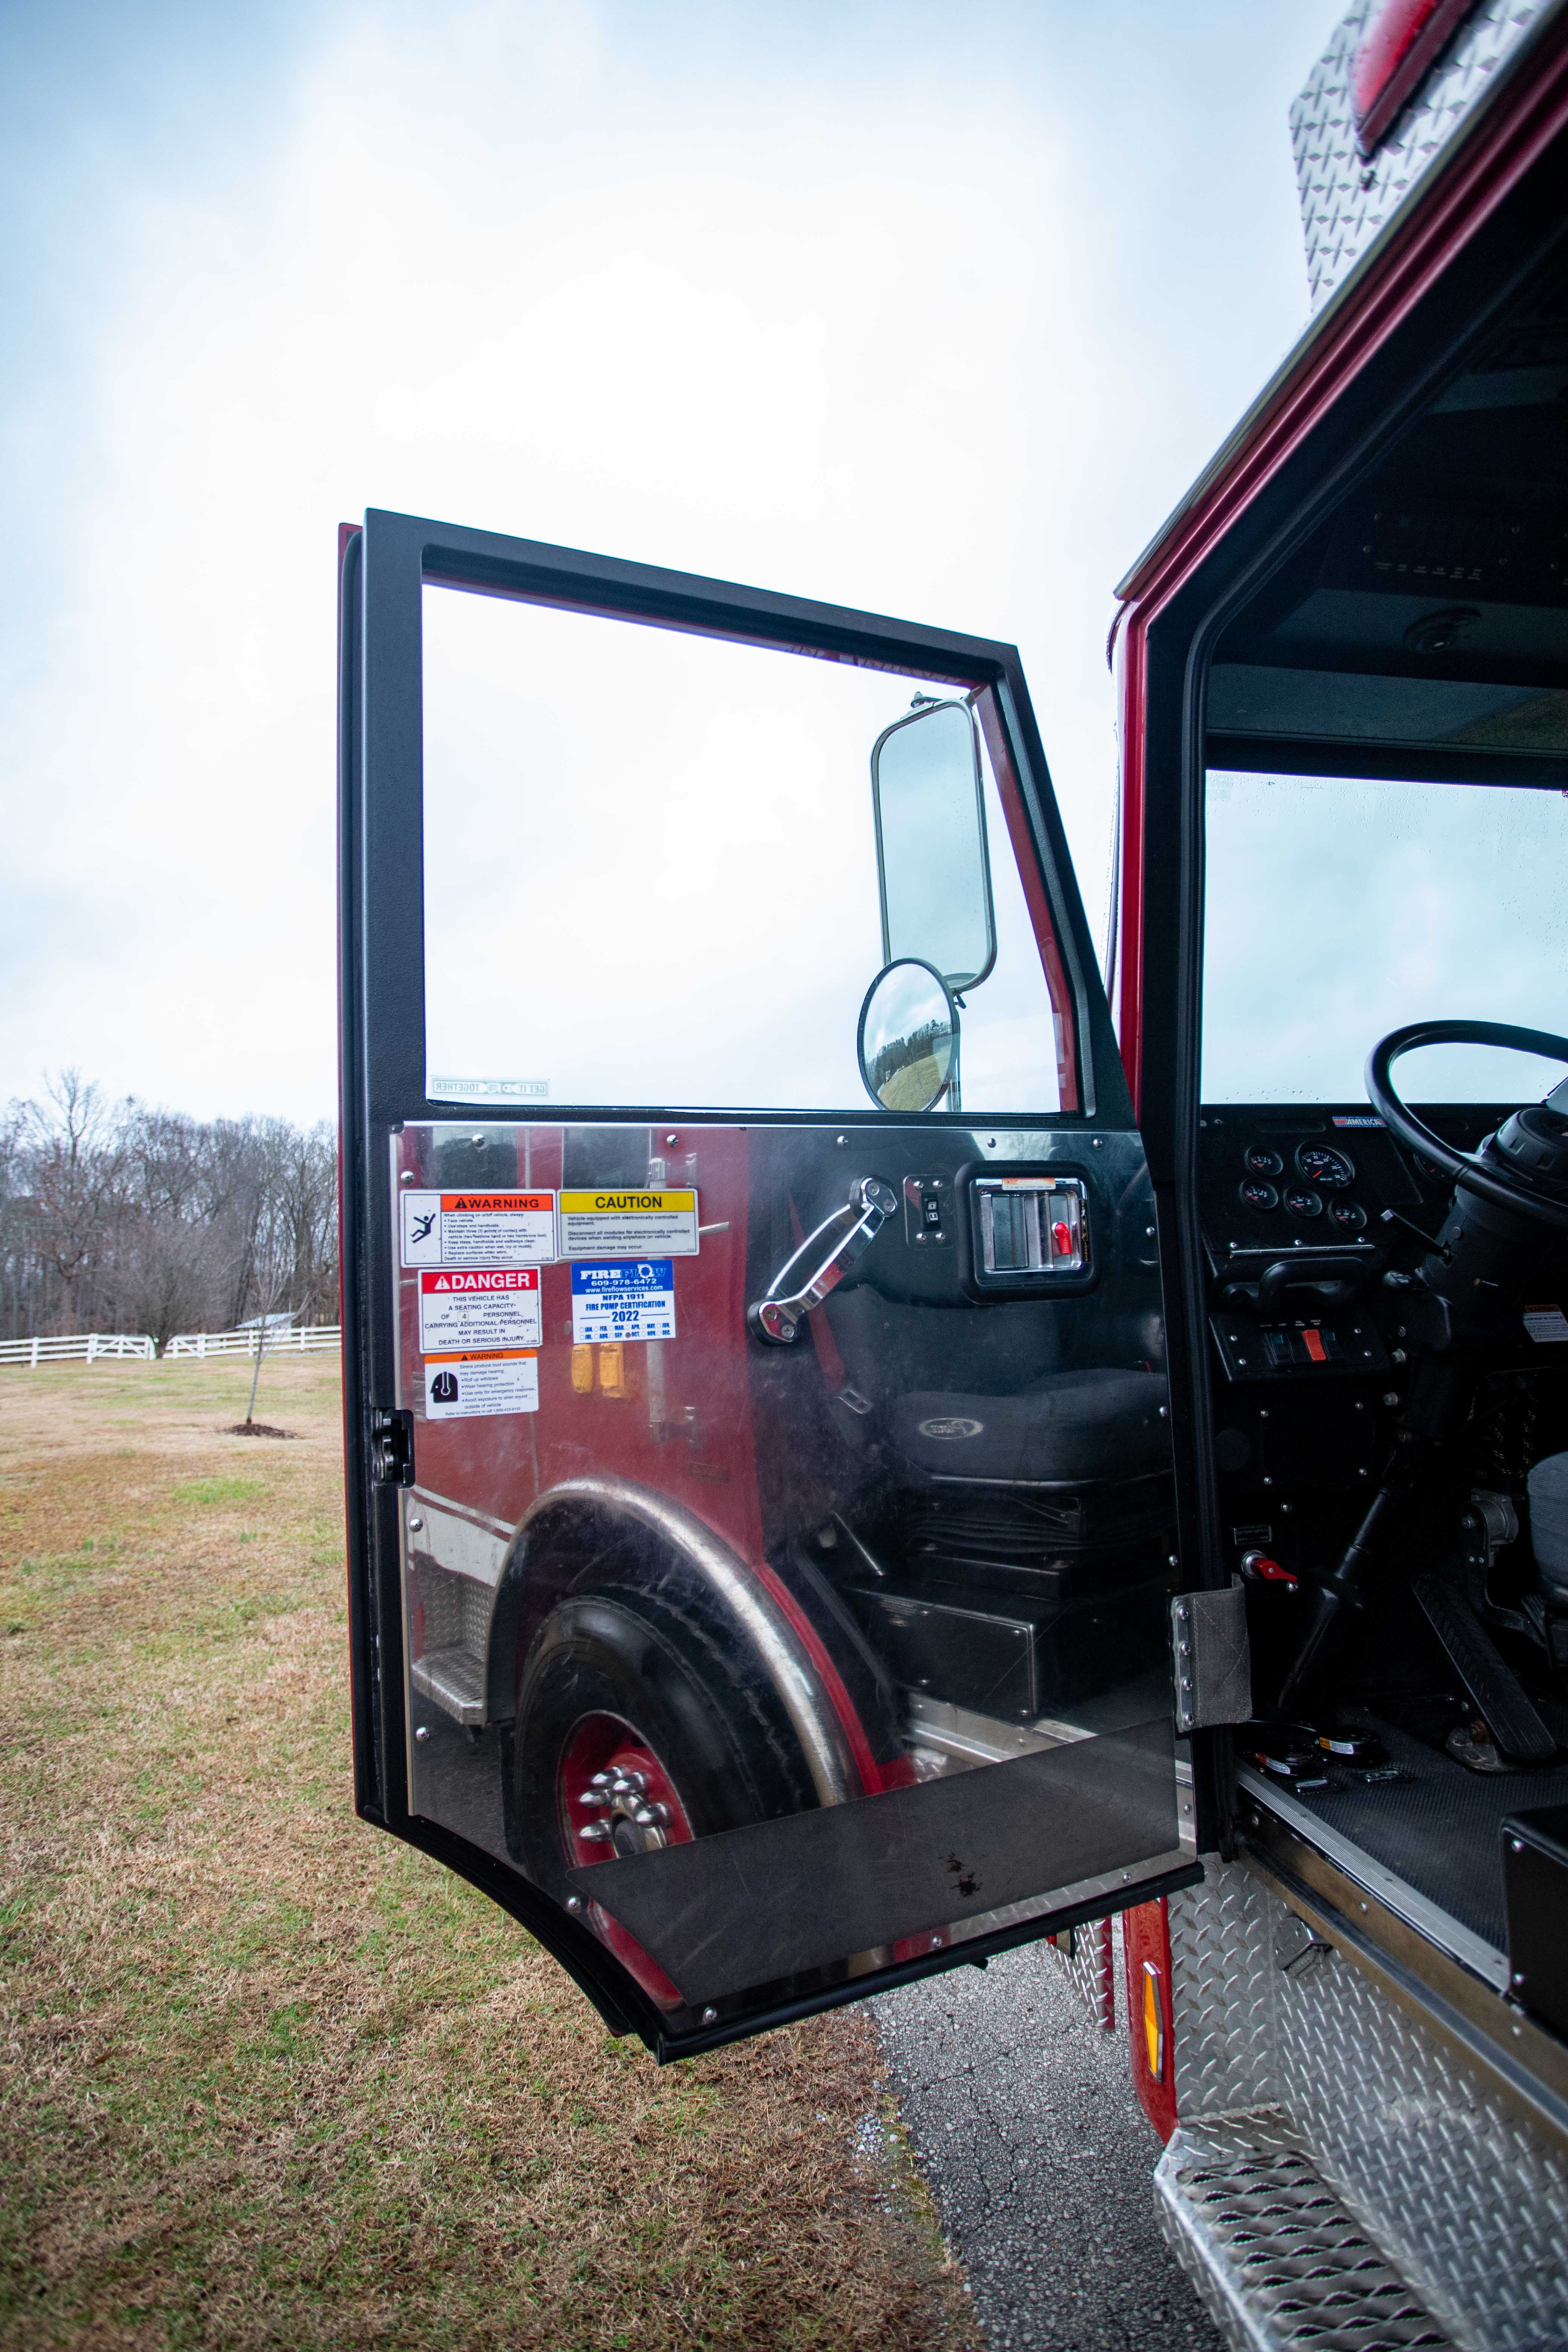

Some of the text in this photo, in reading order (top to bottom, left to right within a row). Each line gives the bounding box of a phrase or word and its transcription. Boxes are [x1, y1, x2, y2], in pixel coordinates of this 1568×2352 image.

[469, 1199, 539, 1208] WARNING
[596, 1197, 662, 1208] CAUTION
[580, 1264, 666, 1280] FIREFLOW
[452, 1273, 530, 1289] DANGER
[620, 1300, 665, 1309] CERTIFICATION
[612, 1311, 639, 1322] 2022
